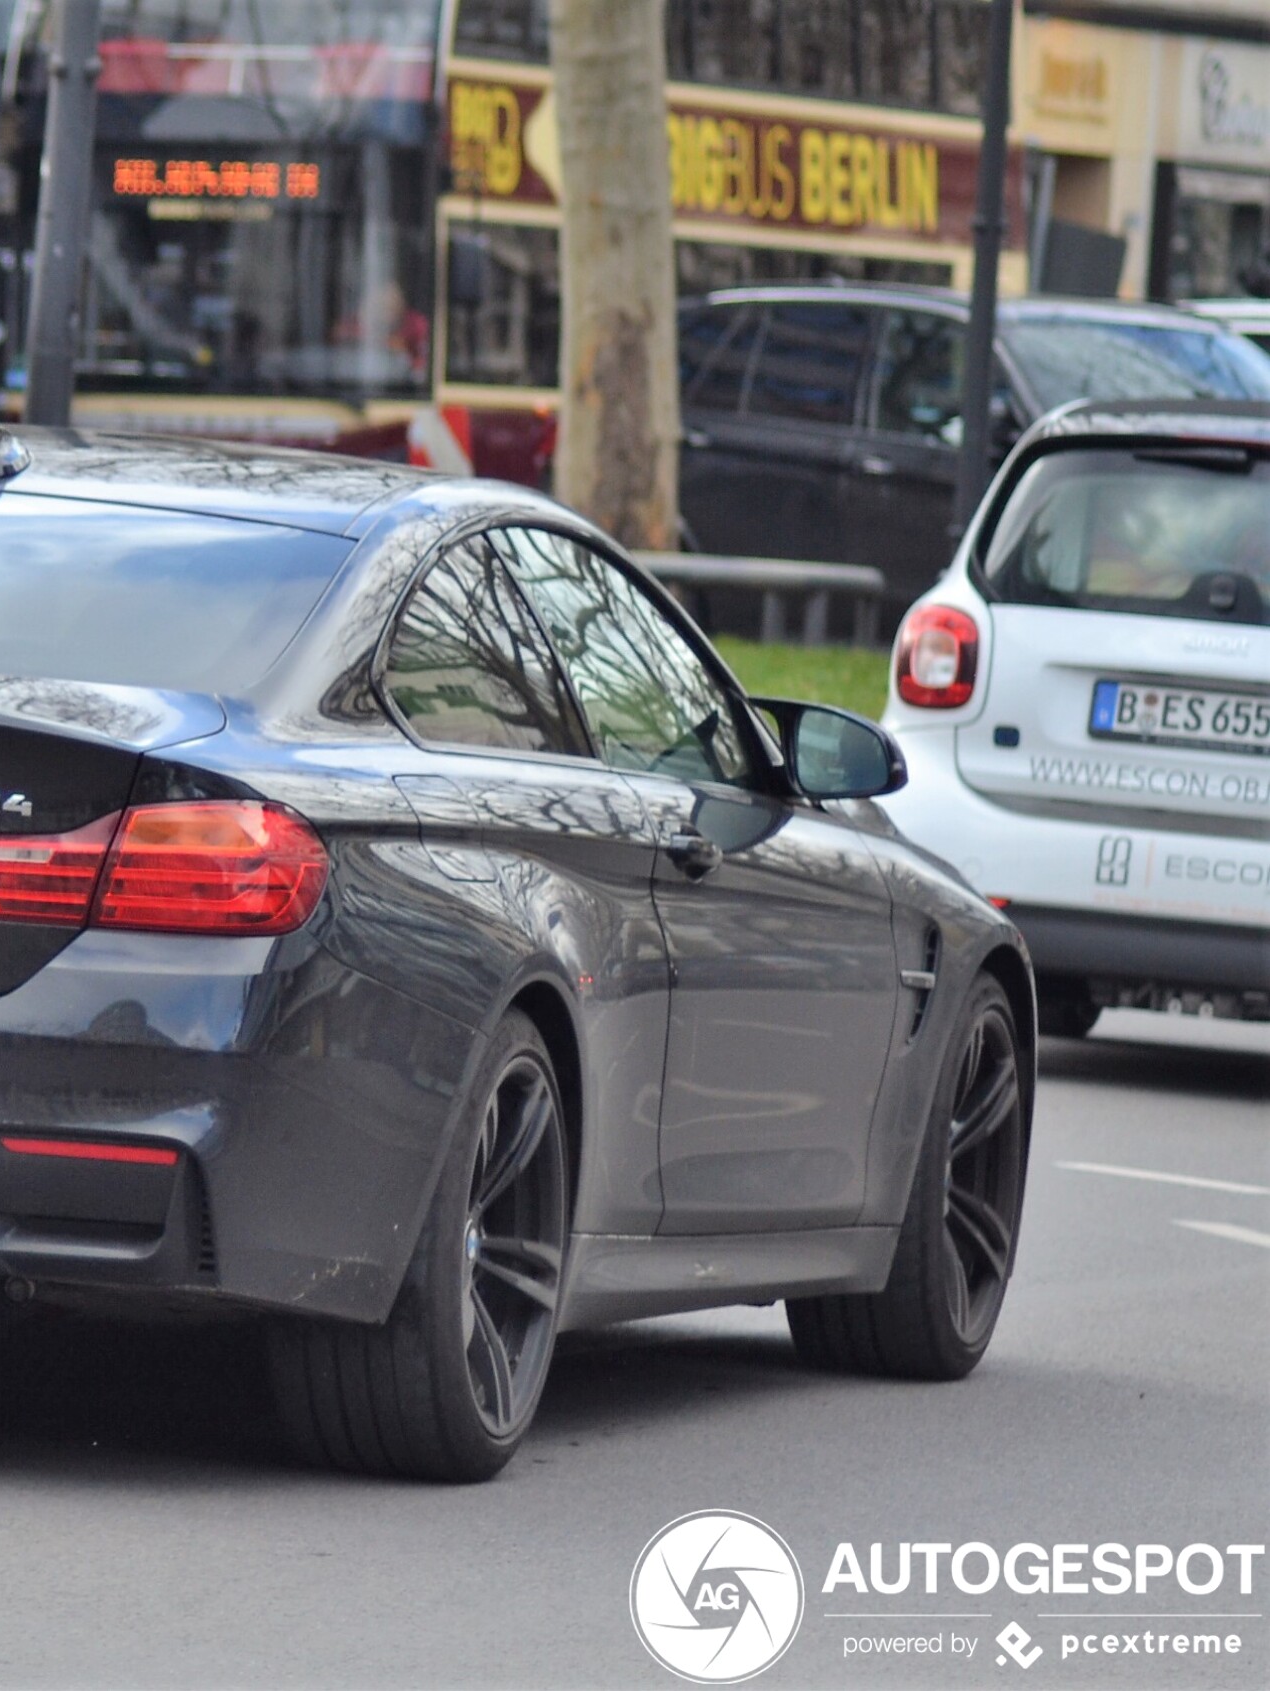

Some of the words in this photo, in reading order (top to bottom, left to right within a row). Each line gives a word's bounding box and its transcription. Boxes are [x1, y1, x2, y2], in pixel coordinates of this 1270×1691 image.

[800, 127, 939, 233] BERLIN
[1117, 690, 1138, 724] B
[1161, 695, 1206, 732] ES
[1165, 854, 1270, 888] ESCO
